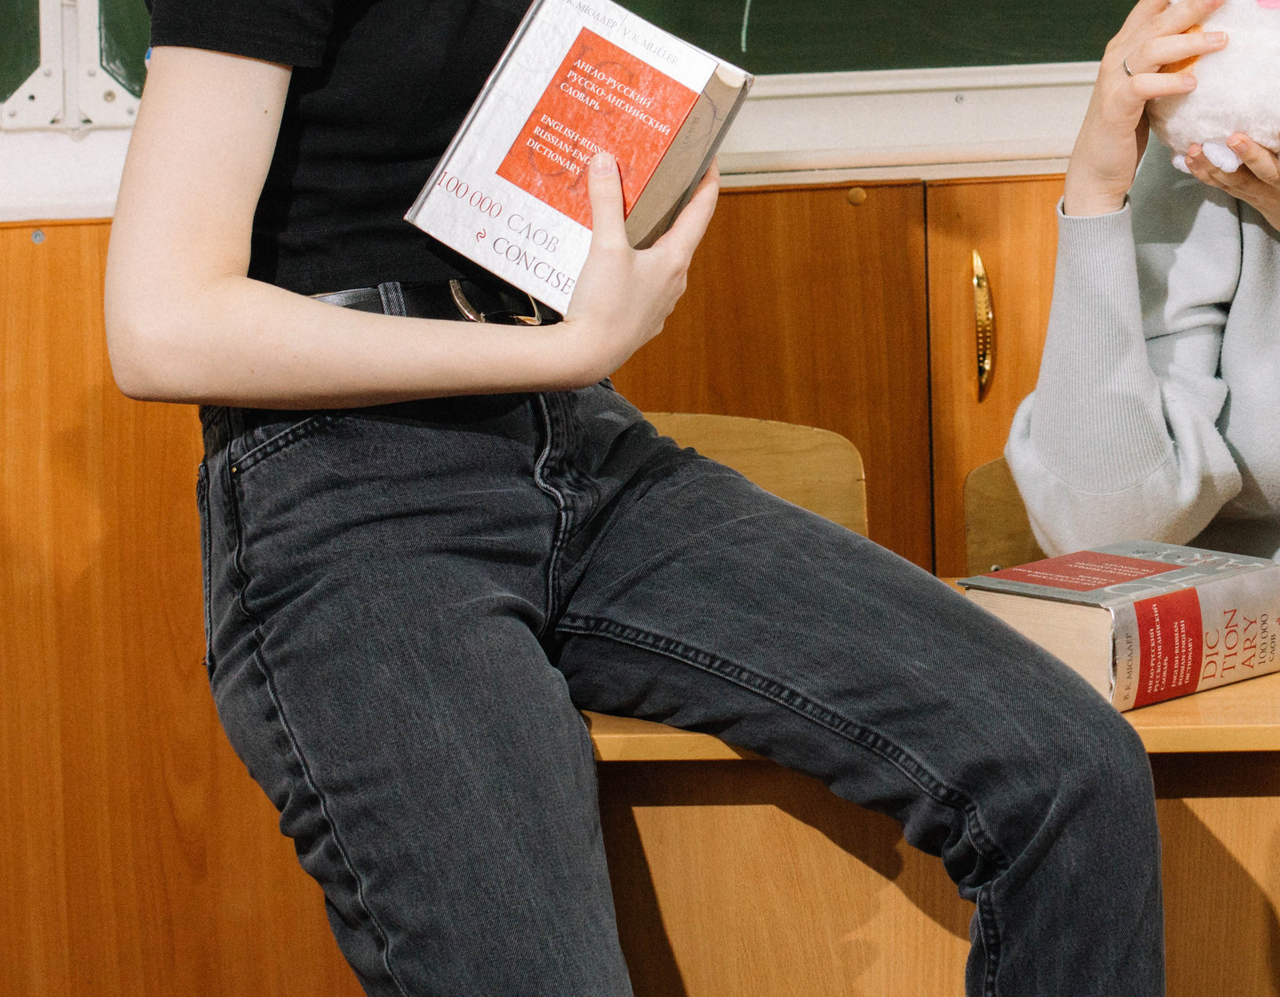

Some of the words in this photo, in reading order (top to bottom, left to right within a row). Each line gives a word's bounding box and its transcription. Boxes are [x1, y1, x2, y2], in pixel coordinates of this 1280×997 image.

[559, 82, 601, 112] СЛОВАРЬ
[566, 69, 671, 137] РУССКО-АНГЛИЙСКИЙ
[573, 58, 653, 109] АНГЛО-РУССКИЙ
[525, 137, 584, 177] DICTIONARY
[532, 125, 594, 166] RUSSIAN-ENG
[540, 113, 618, 161] ENGLISH-RUSS
[437, 171, 470, 199] 100
[469, 190, 503, 219] 000
[506, 212, 560, 254] СЛОВ
[492, 236, 576, 296] CONCISE
[1220, 608, 1240, 679] TION
[1241, 615, 1258, 669] ARY
[1259, 613, 1269, 644] 000
[1268, 633, 1277, 663] СЛОВ
[1125, 632, 1134, 680] МЮЛЛЕР
[1184, 637, 1193, 684] DICTIONARY
[1201, 628, 1220, 681] DIC
[1257, 644, 1268, 666] 100
